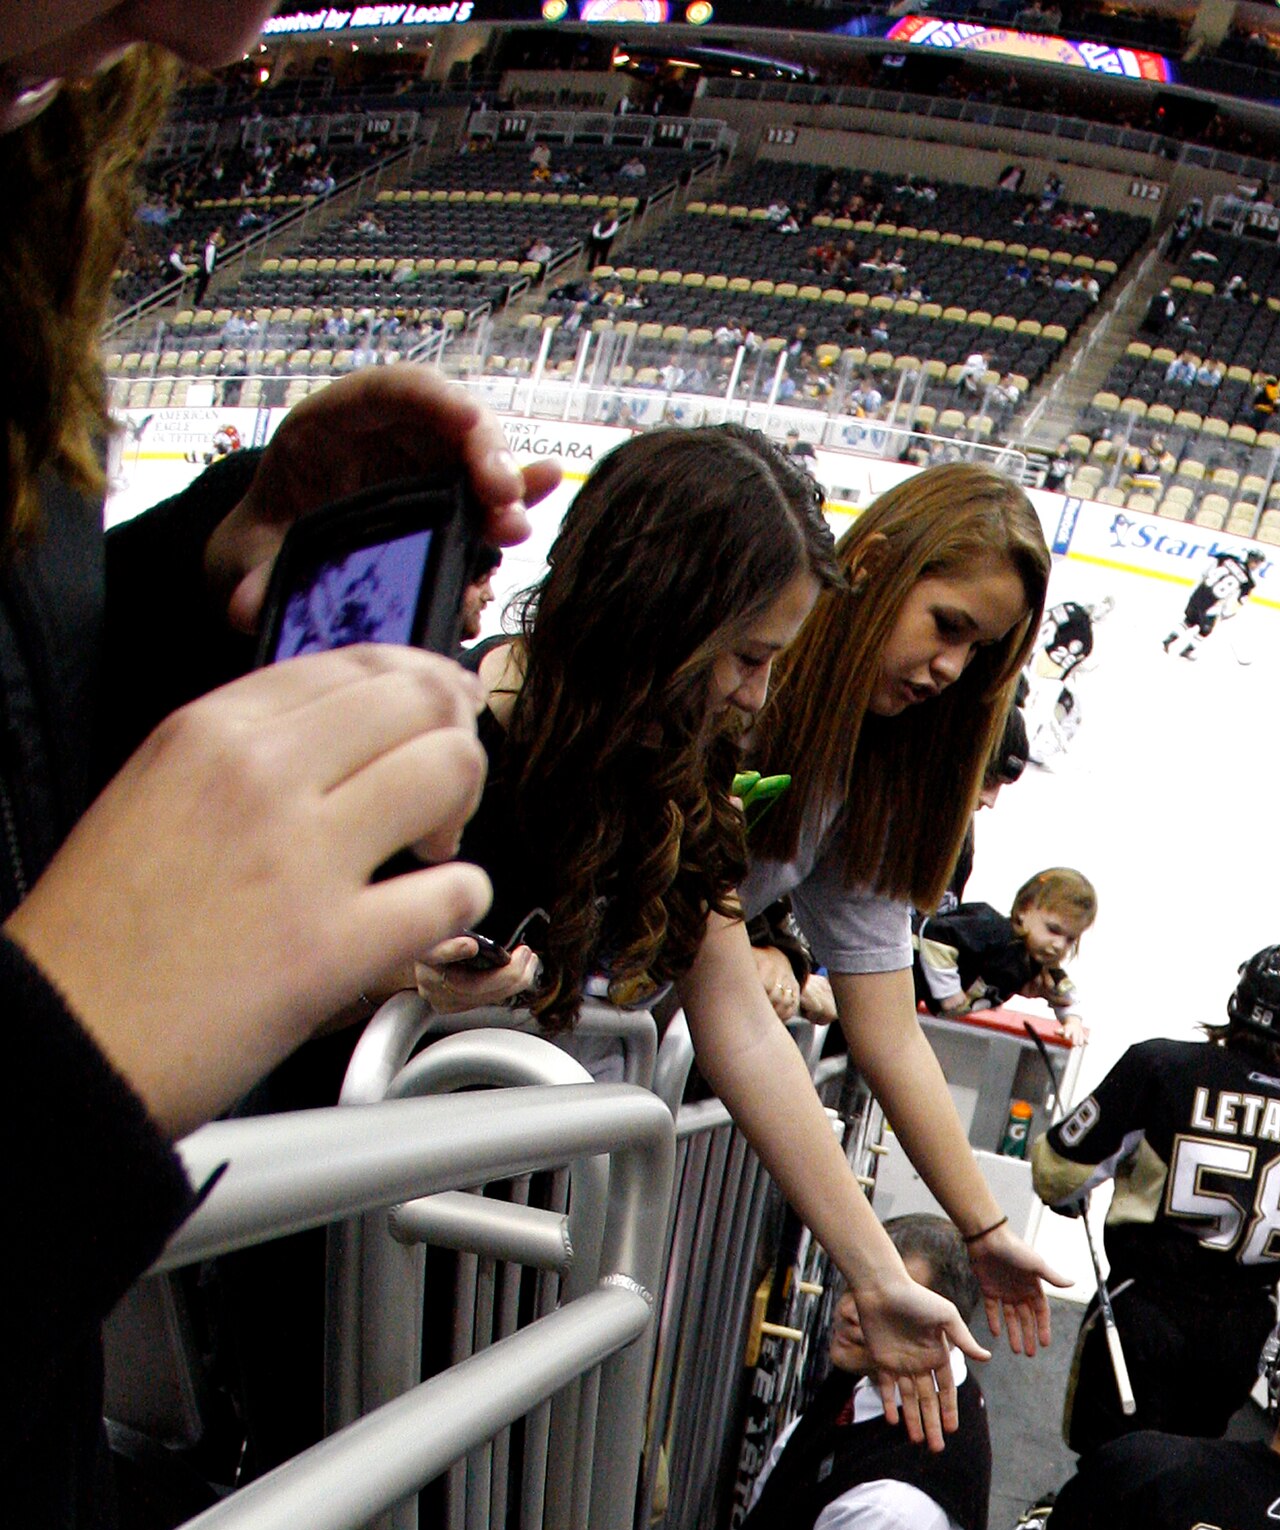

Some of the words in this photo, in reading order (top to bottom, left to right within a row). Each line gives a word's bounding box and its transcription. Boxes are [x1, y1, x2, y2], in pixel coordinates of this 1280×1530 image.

[325, 8, 351, 31] by
[350, 4, 406, 28] IBEW
[402, 1, 459, 26] Local
[455, 1, 475, 24] 5
[767, 128, 796, 145] 112
[1130, 181, 1161, 200] 112
[1250, 211, 1280, 232] 113
[159, 409, 220, 421] AMERICAN
[155, 421, 191, 433] EAGLE
[502, 422, 542, 436] FIRST
[1131, 522, 1275, 579] StarKt
[1250, 1004, 1275, 1026] 58
